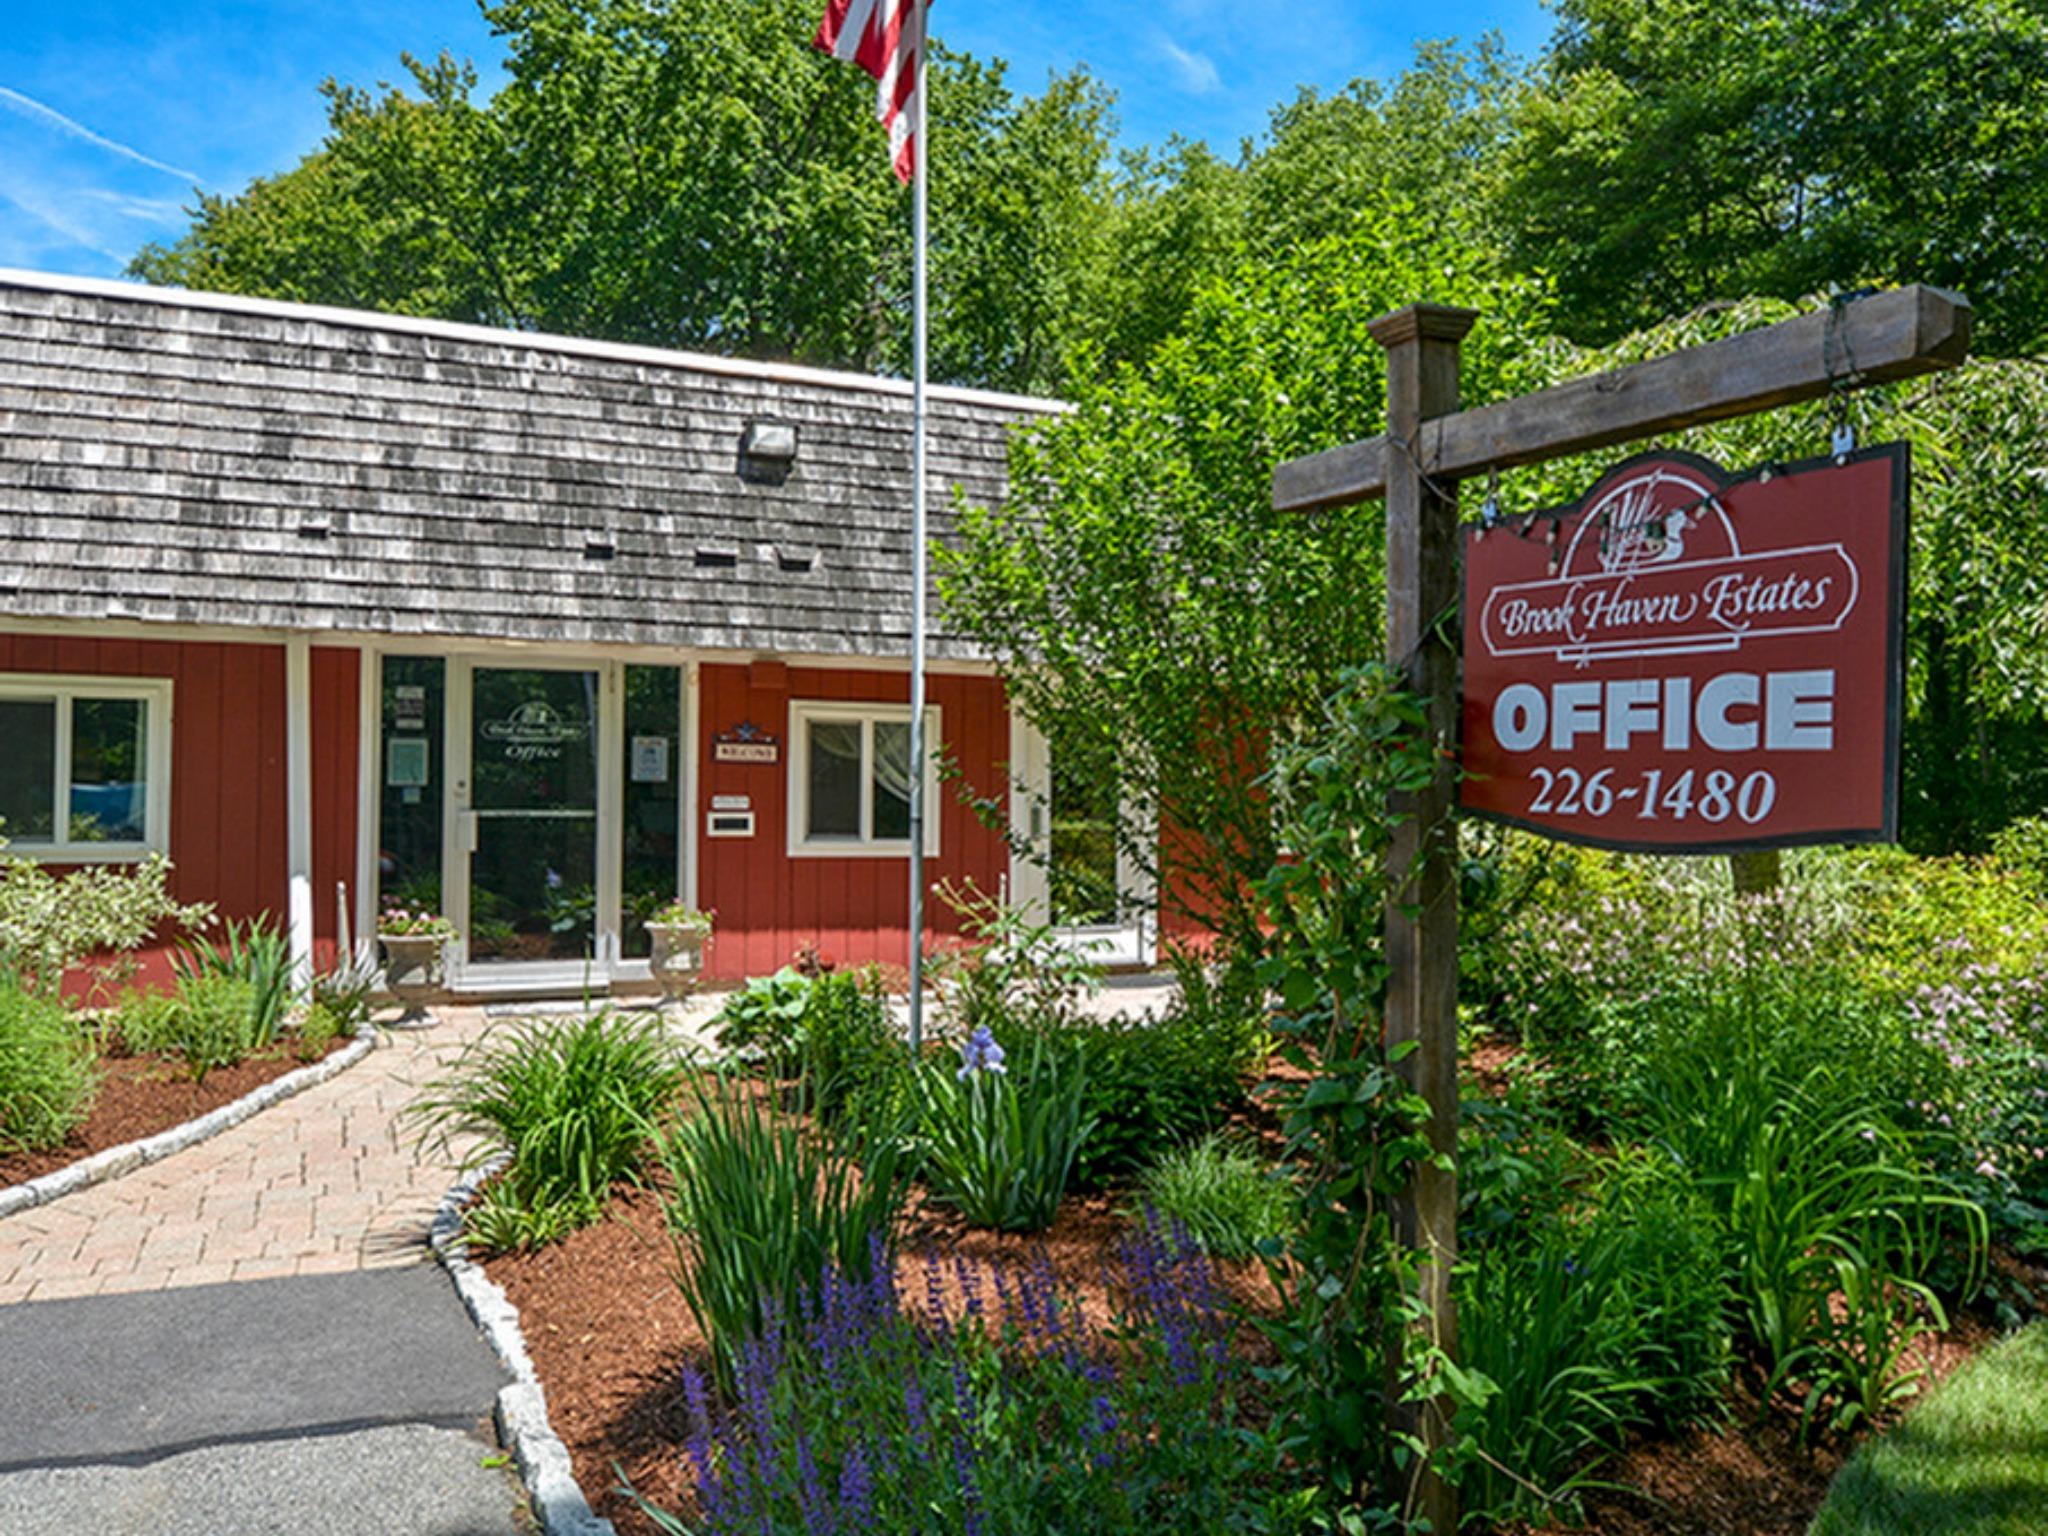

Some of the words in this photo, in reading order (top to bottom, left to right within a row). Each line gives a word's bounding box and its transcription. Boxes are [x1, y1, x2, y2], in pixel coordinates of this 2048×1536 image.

[1500, 582, 1588, 642] Brook
[1582, 575, 1698, 630] Haven
[1703, 572, 1832, 632] Estates
[1493, 669, 1835, 752] OFFICE
